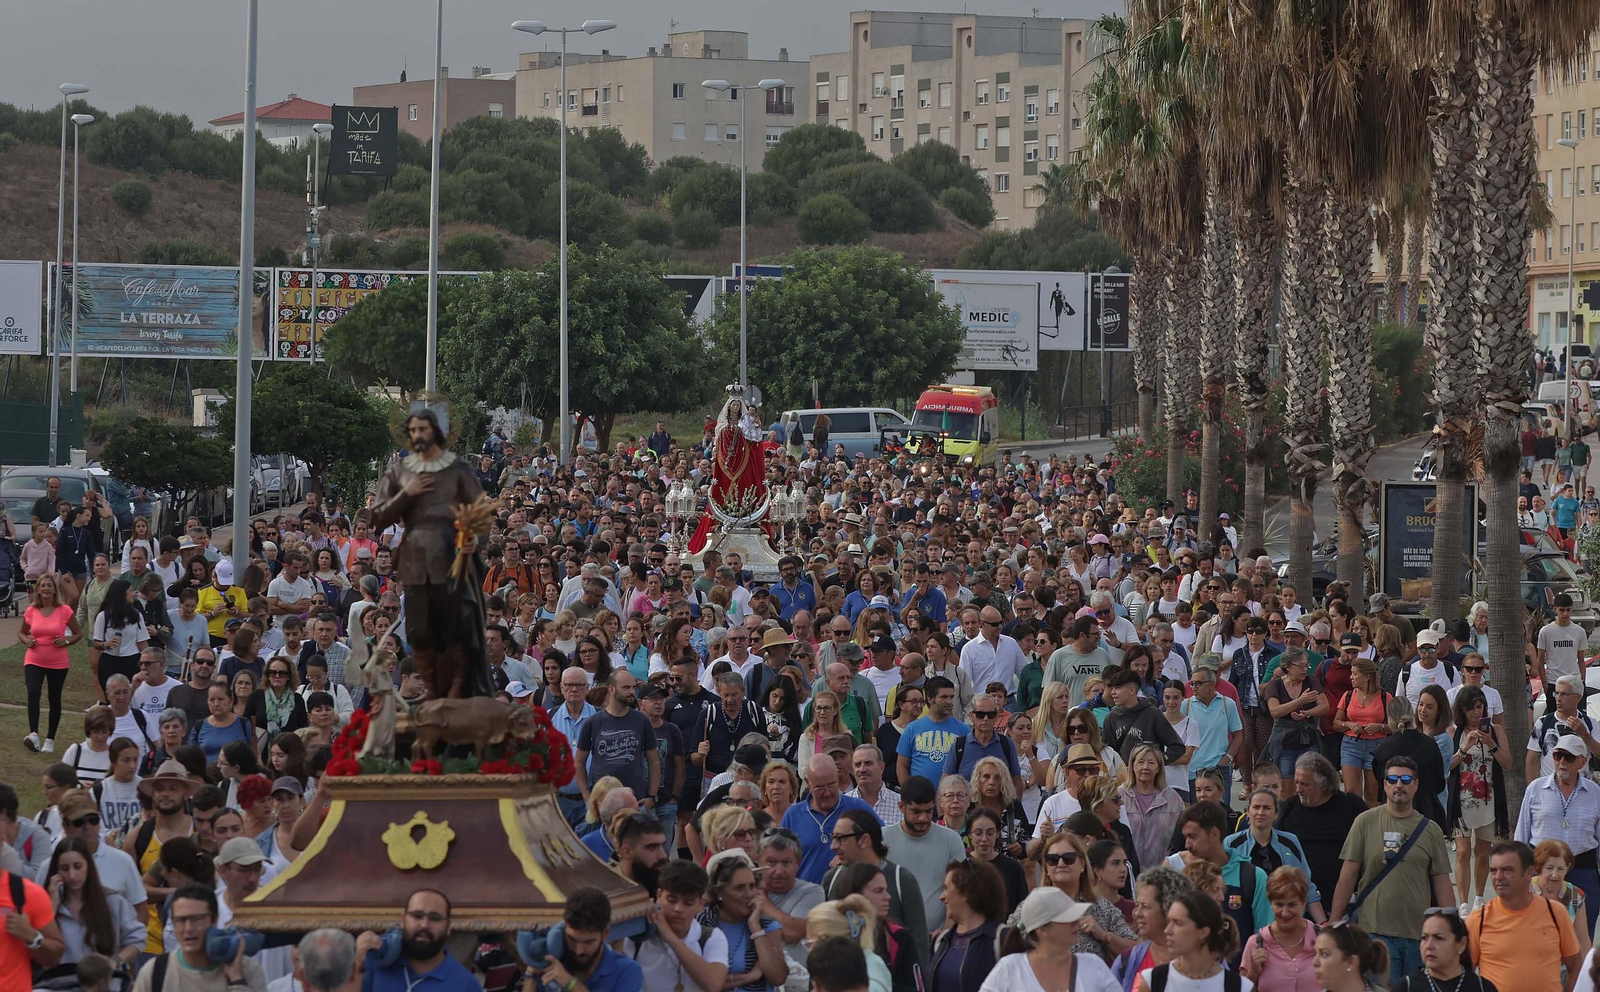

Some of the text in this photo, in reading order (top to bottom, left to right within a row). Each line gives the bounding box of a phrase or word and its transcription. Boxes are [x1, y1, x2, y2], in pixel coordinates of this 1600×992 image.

[348, 133, 372, 141] made
[347, 151, 382, 165] TARIFA
[120, 312, 201, 324] LA TERRAZA
[1072, 664, 1100, 674] VANS
